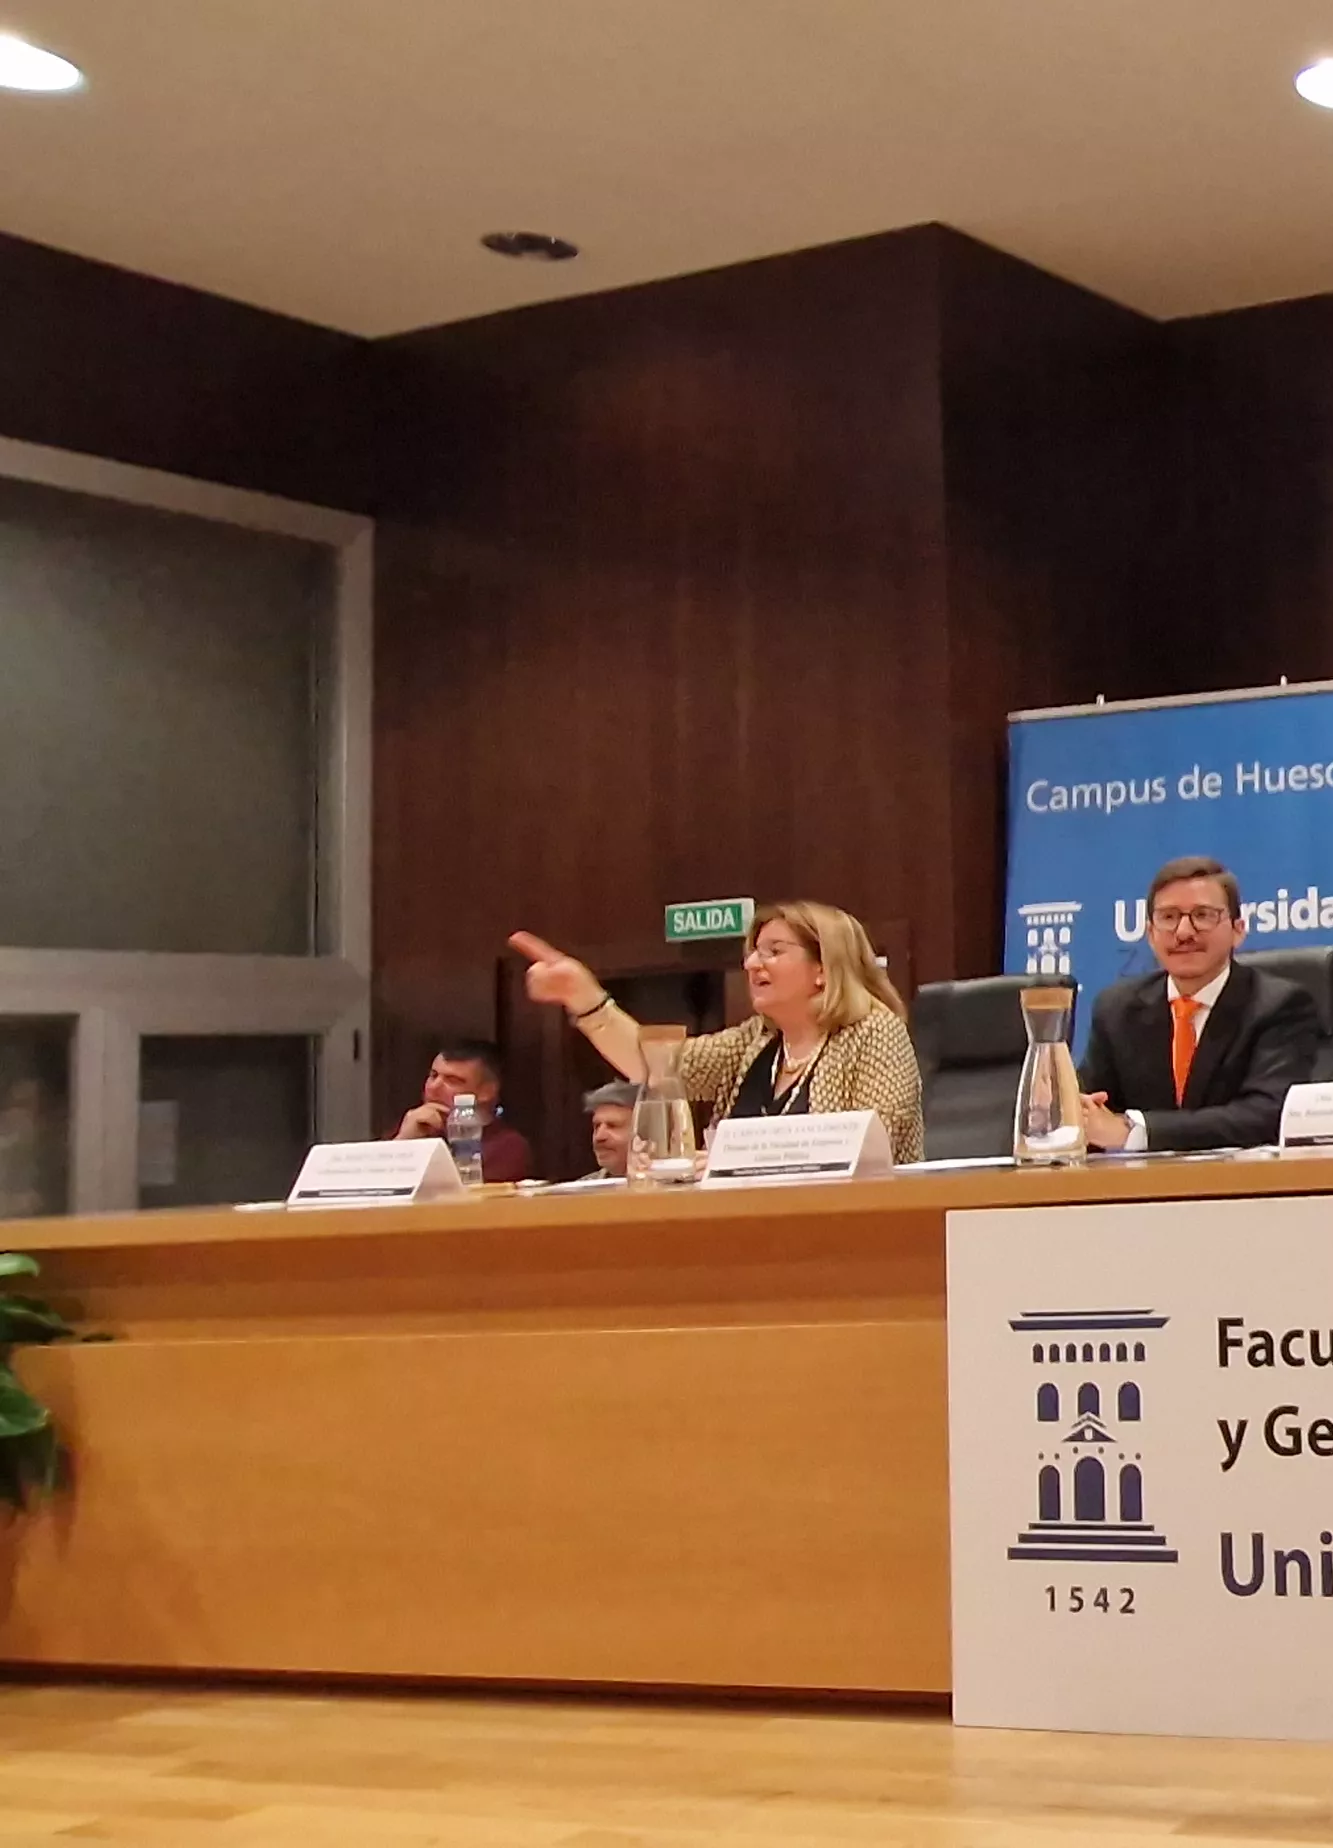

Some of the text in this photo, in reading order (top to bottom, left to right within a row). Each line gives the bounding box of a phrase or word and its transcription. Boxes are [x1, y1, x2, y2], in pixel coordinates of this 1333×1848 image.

[1027, 777, 1166, 815] Campus
[1177, 763, 1222, 800] de
[673, 907, 736, 933] SALIDA
[1216, 1419, 1249, 1473] y
[1046, 1585, 1135, 1615] 1542
